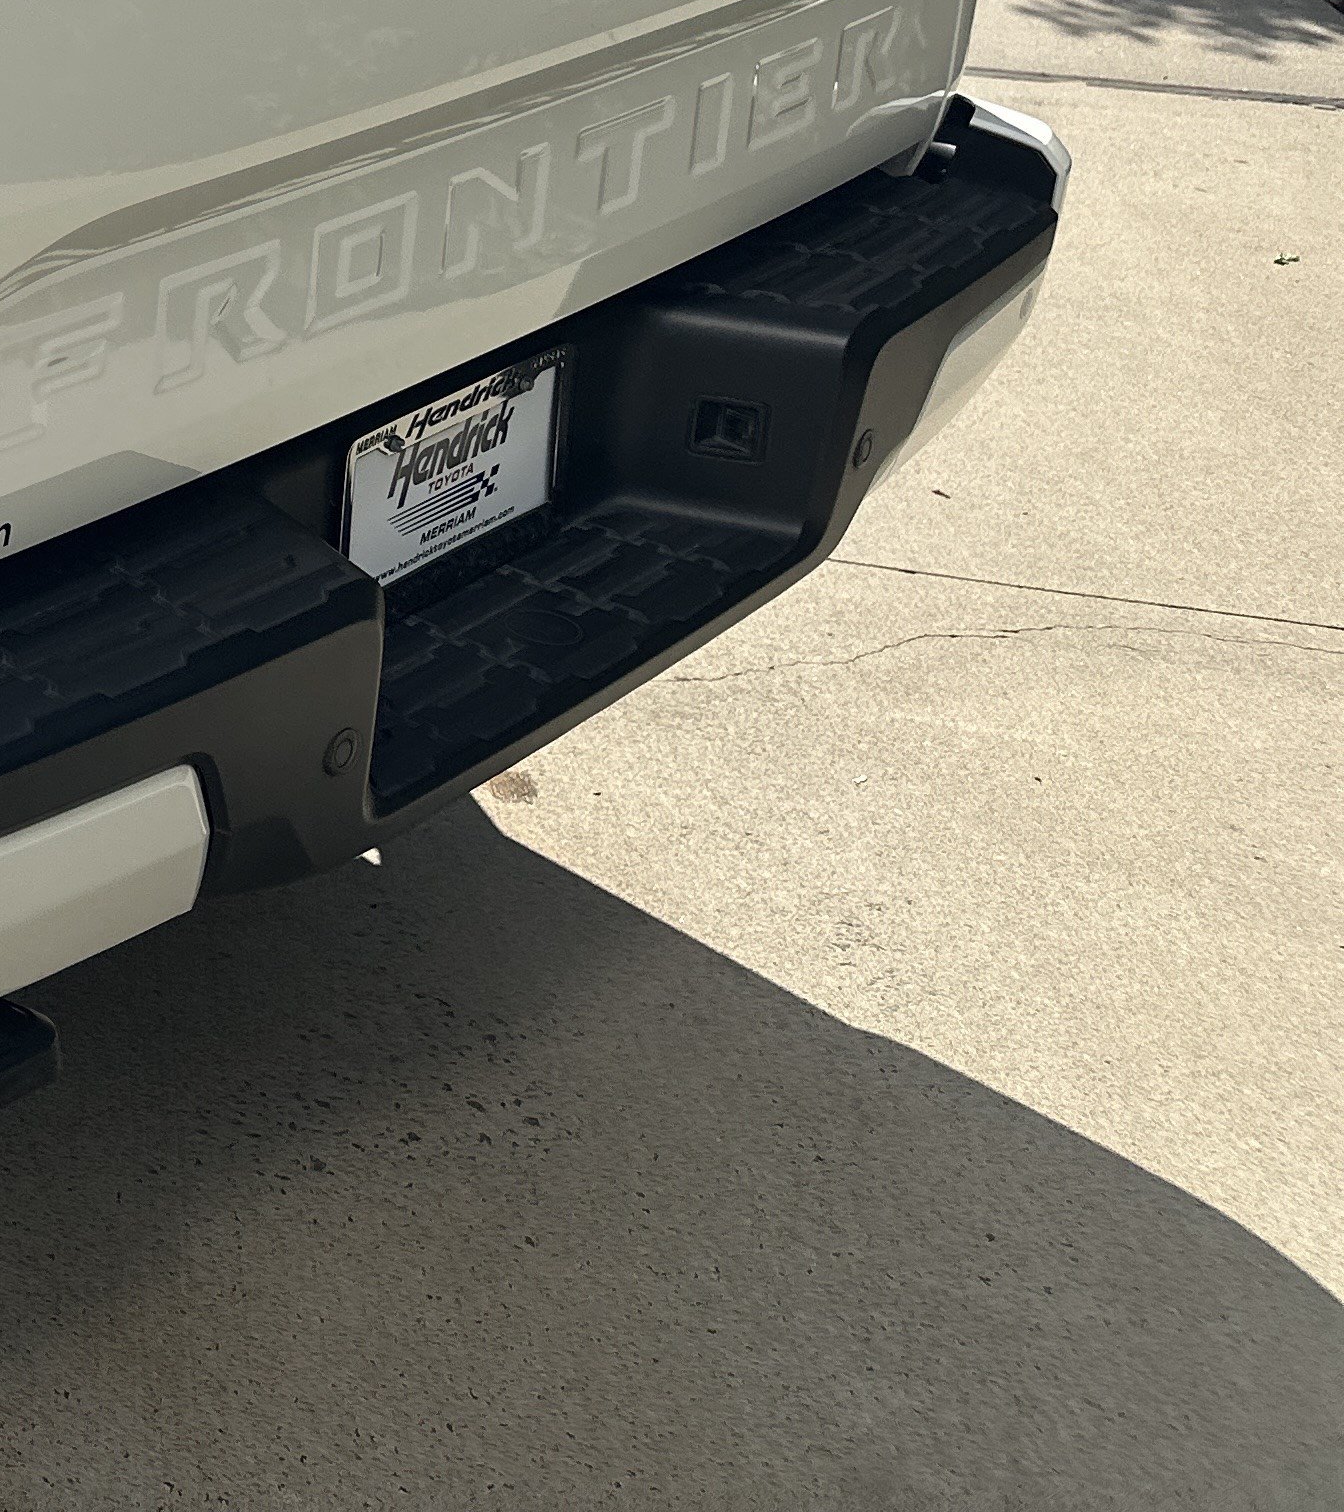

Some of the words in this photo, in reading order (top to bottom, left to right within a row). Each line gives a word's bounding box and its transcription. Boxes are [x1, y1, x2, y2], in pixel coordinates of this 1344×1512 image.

[386, 399, 515, 510] Hendrick
[427, 462, 474, 495] TOYOTA
[419, 506, 477, 546] MERRIAM
